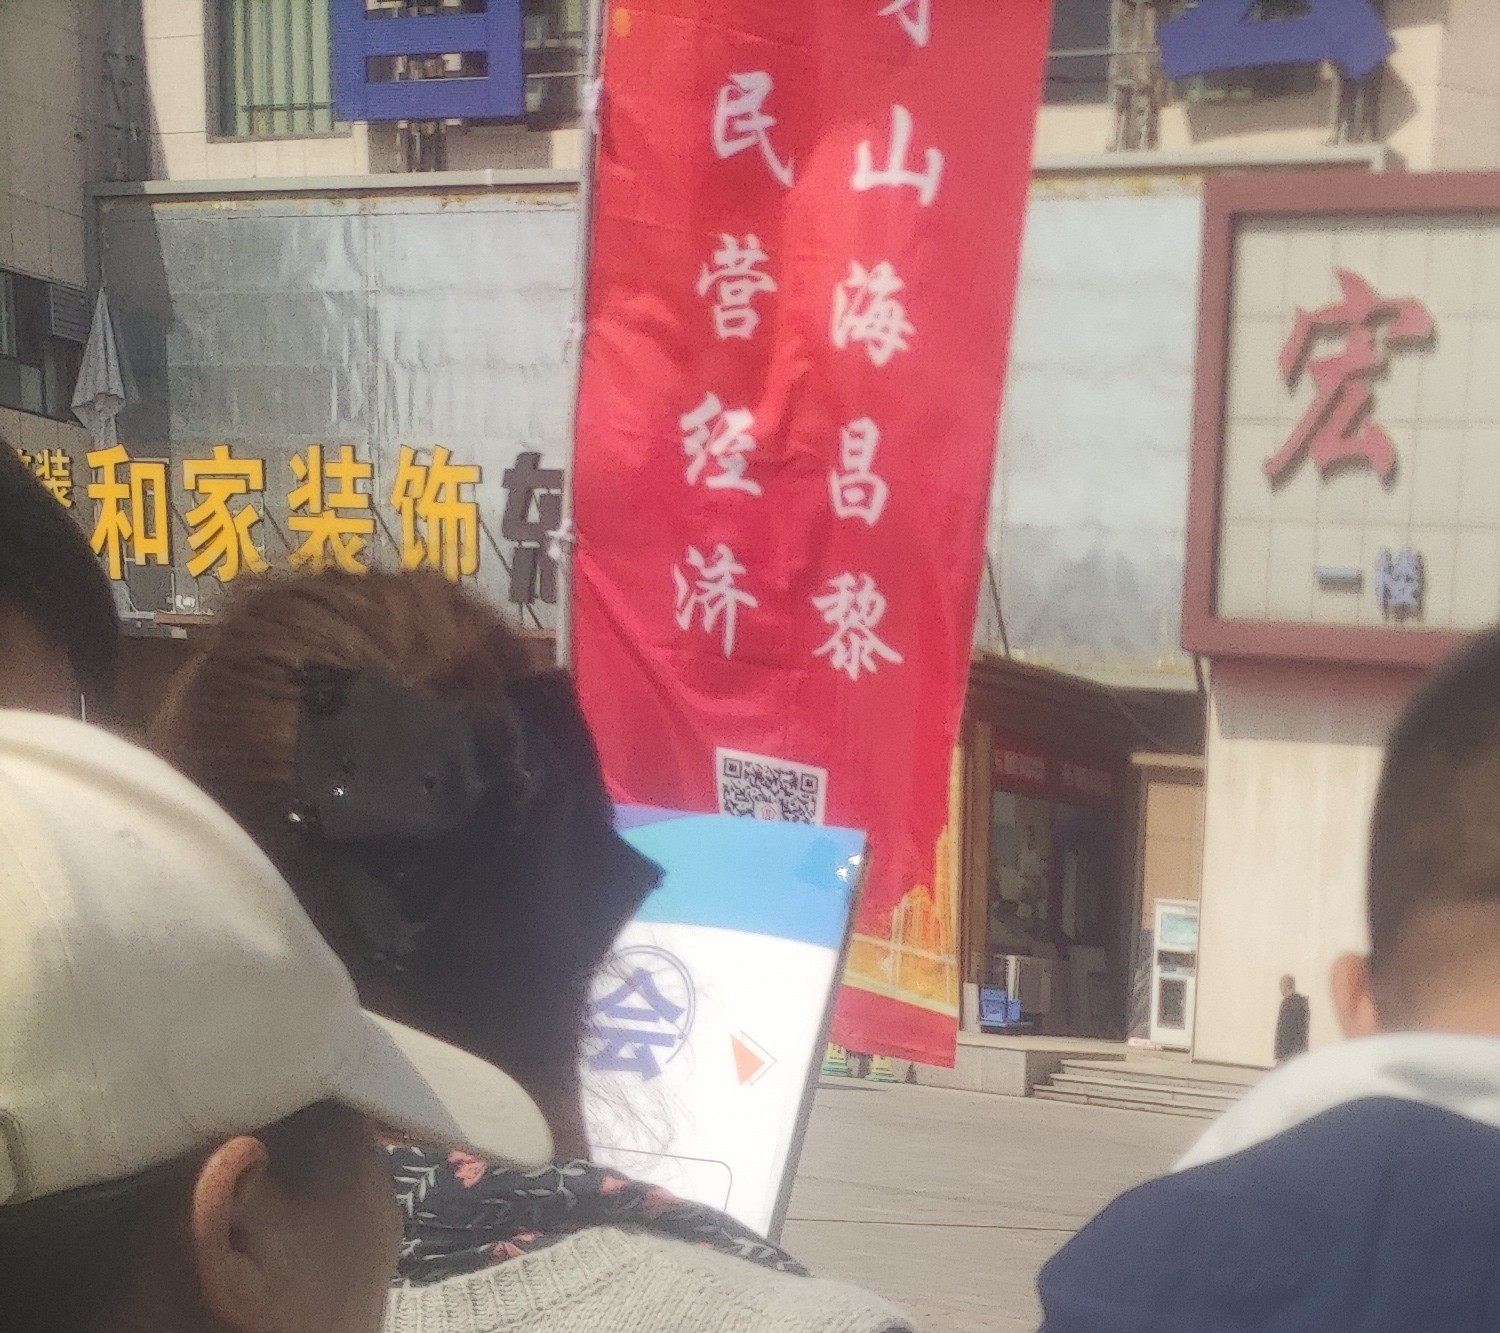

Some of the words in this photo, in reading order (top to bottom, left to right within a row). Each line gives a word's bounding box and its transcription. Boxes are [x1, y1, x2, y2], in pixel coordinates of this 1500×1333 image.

[673, 69, 795, 660] 民营经济
[86, 443, 484, 583] 和家装饰
[587, 965, 687, 1082] 会
